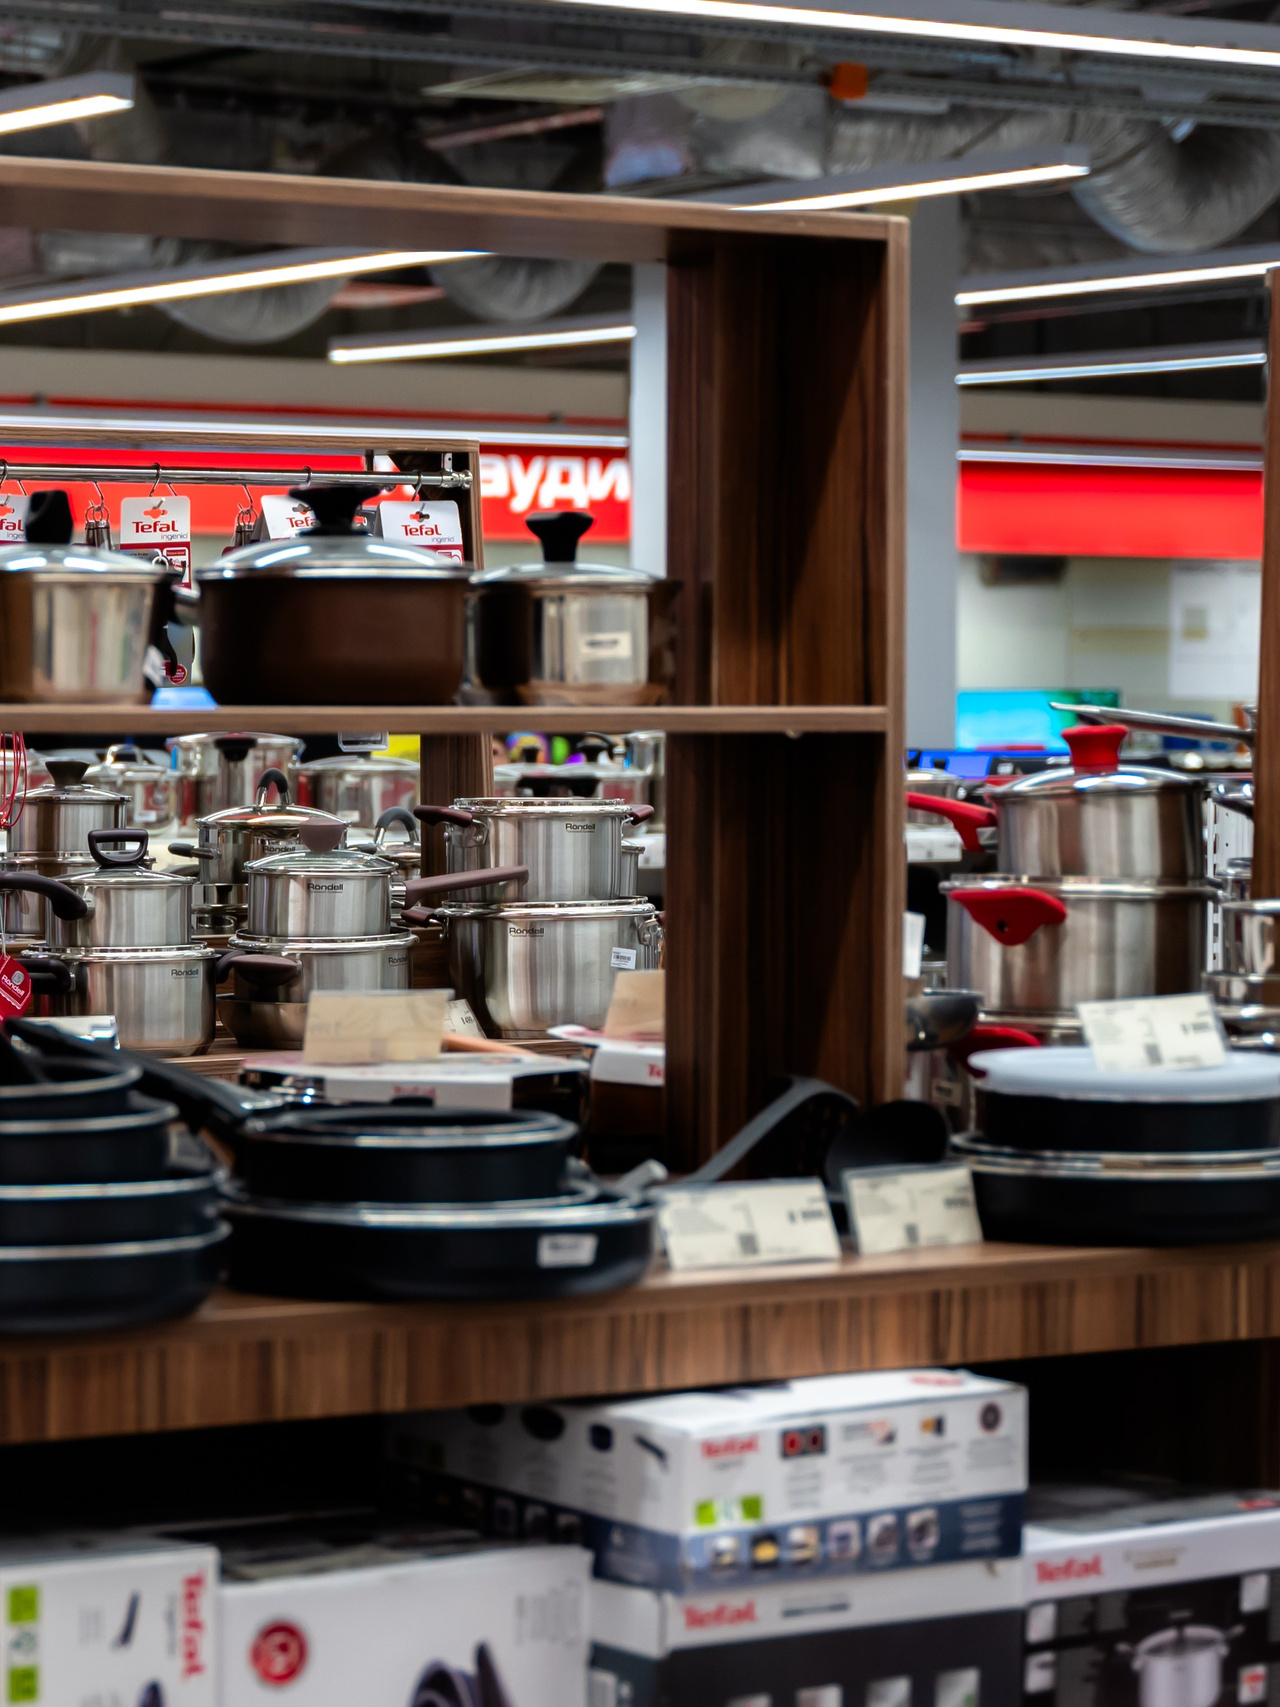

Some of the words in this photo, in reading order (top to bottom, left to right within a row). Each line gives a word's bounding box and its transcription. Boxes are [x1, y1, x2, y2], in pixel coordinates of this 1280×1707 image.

[132, 520, 178, 534] Tefal
[286, 516, 317, 528] Tefa
[401, 524, 442, 536] Tefal
[160, 532, 187, 541] ingenio
[431, 536, 455, 544] ingenio
